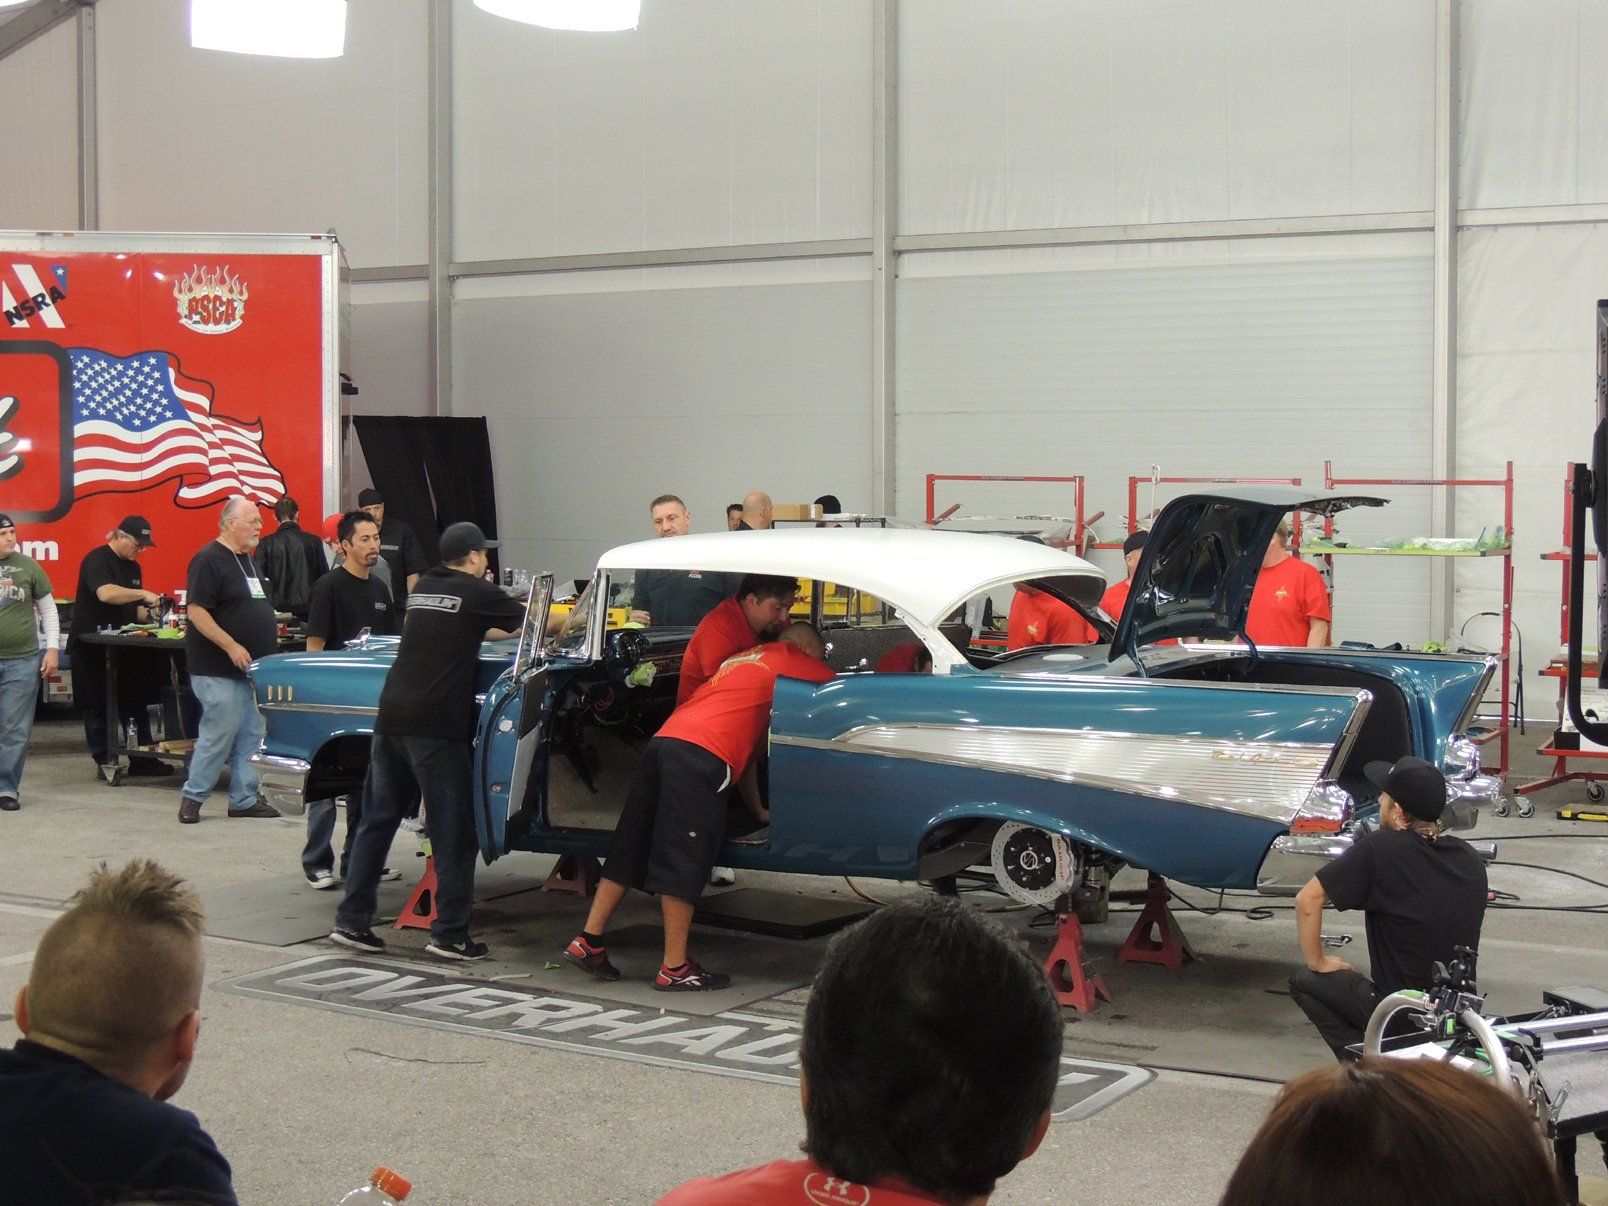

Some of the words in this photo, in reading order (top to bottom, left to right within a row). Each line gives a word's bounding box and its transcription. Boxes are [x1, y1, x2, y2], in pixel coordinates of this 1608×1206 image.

[3, 285, 66, 326] NSRA
[188, 294, 238, 326] PSCA
[274, 966, 802, 1069] OVERHAU
